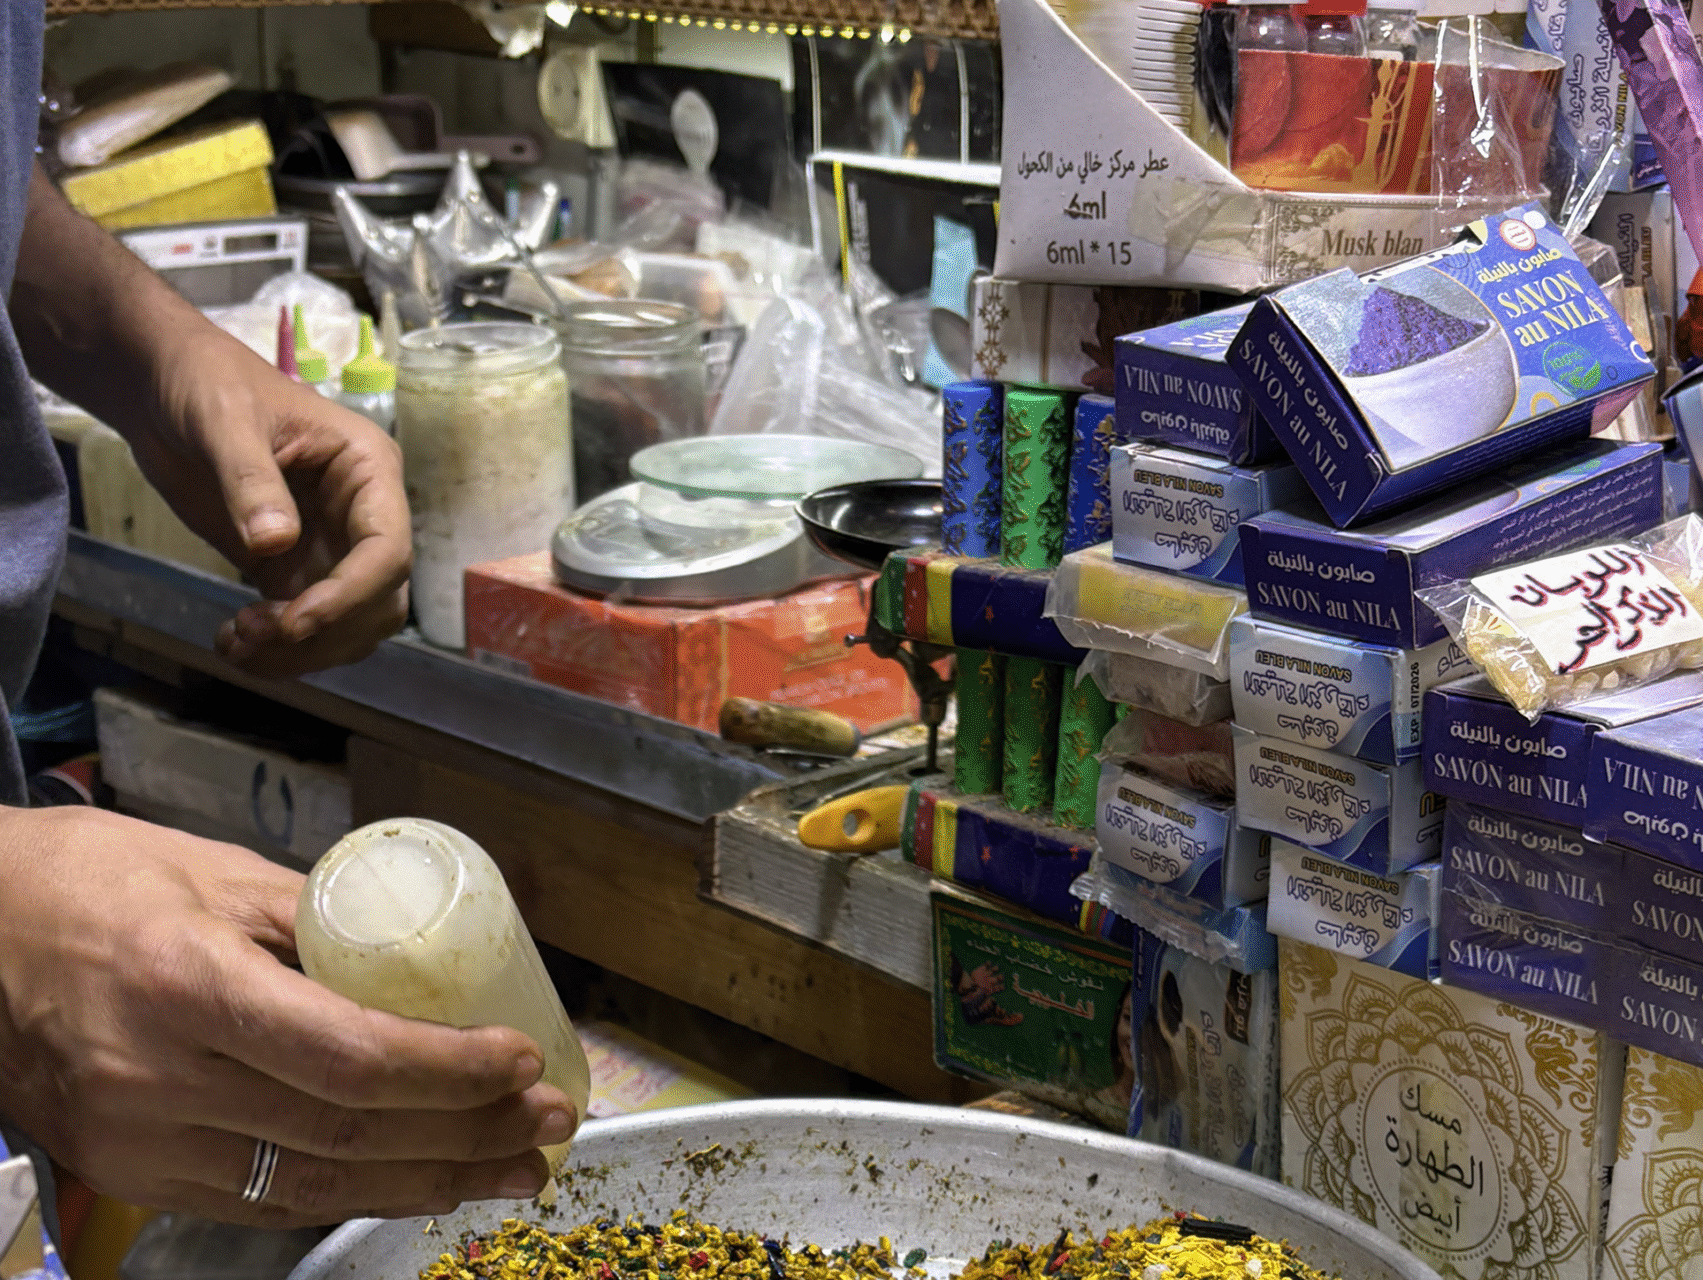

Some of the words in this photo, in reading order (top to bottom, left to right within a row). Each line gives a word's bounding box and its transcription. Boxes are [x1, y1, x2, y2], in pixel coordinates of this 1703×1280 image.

[1056, 157, 1073, 178] من
[1078, 151, 1102, 184] خالي
[1107, 149, 1135, 178] مركز
[1139, 149, 1169, 178] عطر
[1047, 239, 1085, 264] 6ml
[1107, 241, 1131, 265] 15
[1320, 229, 1378, 256] Musk
[1477, 259, 1520, 284] بالنيلة
[1518, 248, 1563, 274] صابون
[1497, 269, 1585, 319] SAVON
[1514, 320, 1549, 347] au
[1534, 294, 1609, 339] NILA
[1268, 331, 1308, 388] بالنيلة
[1123, 365, 1160, 396] NILA
[1163, 374, 1183, 392] au
[1187, 380, 1243, 414] SAVON
[1141, 410, 1189, 433] صابون
[1190, 418, 1231, 445] بالنيلة
[1239, 338, 1295, 417] SAVON
[1289, 415, 1312, 446] au
[1308, 440, 1349, 502] NILA
[1304, 387, 1349, 450] صابون
[1134, 469, 1162, 487] BLEU
[1162, 475, 1187, 491] NILA
[1188, 478, 1224, 498] SAVON
[1123, 489, 1174, 523] النيلة
[1155, 531, 1212, 561] صابون
[1267, 550, 1315, 574] بالنيلة
[1318, 561, 1376, 584] صابون
[1257, 581, 1321, 614] SAVON
[1326, 600, 1351, 619] au
[1353, 599, 1401, 631] NILA
[1255, 650, 1286, 669] BLEU
[1286, 657, 1312, 674] NILA
[1313, 663, 1352, 683] SAVON
[1243, 669, 1297, 705] النيلة
[1299, 681, 1369, 718] الزرقاء
[1277, 714, 1339, 744] صابون
[1410, 720, 1420, 743] EXP
[1450, 720, 1500, 749] بالنيلة
[1260, 747, 1290, 767] BLEU
[1505, 735, 1567, 759] صابون
[1289, 755, 1318, 774] NILA
[1317, 763, 1356, 786] SAVON
[1604, 756, 1658, 797] NILA
[1249, 763, 1307, 799] النيلة
[1434, 752, 1503, 790] SAVON
[1508, 774, 1532, 796] au
[1538, 776, 1588, 808] NILA
[1663, 774, 1689, 800] au
[1163, 806, 1196, 830] SAVON
[1285, 806, 1343, 841] صابون
[1467, 815, 1518, 843] بالنيلة
[1623, 811, 1689, 841] صابون
[1521, 830, 1584, 857] صابون
[1301, 857, 1333, 877] BLEU
[1333, 866, 1360, 885] NILA
[1451, 846, 1521, 884] SAVON
[1525, 868, 1549, 892] au
[1554, 871, 1605, 907] NILA
[1360, 874, 1399, 896] SAVON
[1652, 868, 1703, 902] النيلة
[1287, 875, 1344, 913] النيلة
[1345, 891, 1414, 930] الزرقاء
[1316, 919, 1379, 955] صابون
[1523, 924, 1583, 954] صابون
[1448, 940, 1520, 980] SAVON
[1520, 964, 1544, 989] au
[1549, 966, 1599, 1005] NILA
[1641, 965, 1698, 998] بالنيلة
[1621, 996, 1698, 1043] SAVON
[1400, 1083, 1462, 1136] مسك
[1385, 1115, 1483, 1196] الطهارة
[1404, 1190, 1462, 1240] أبيض
